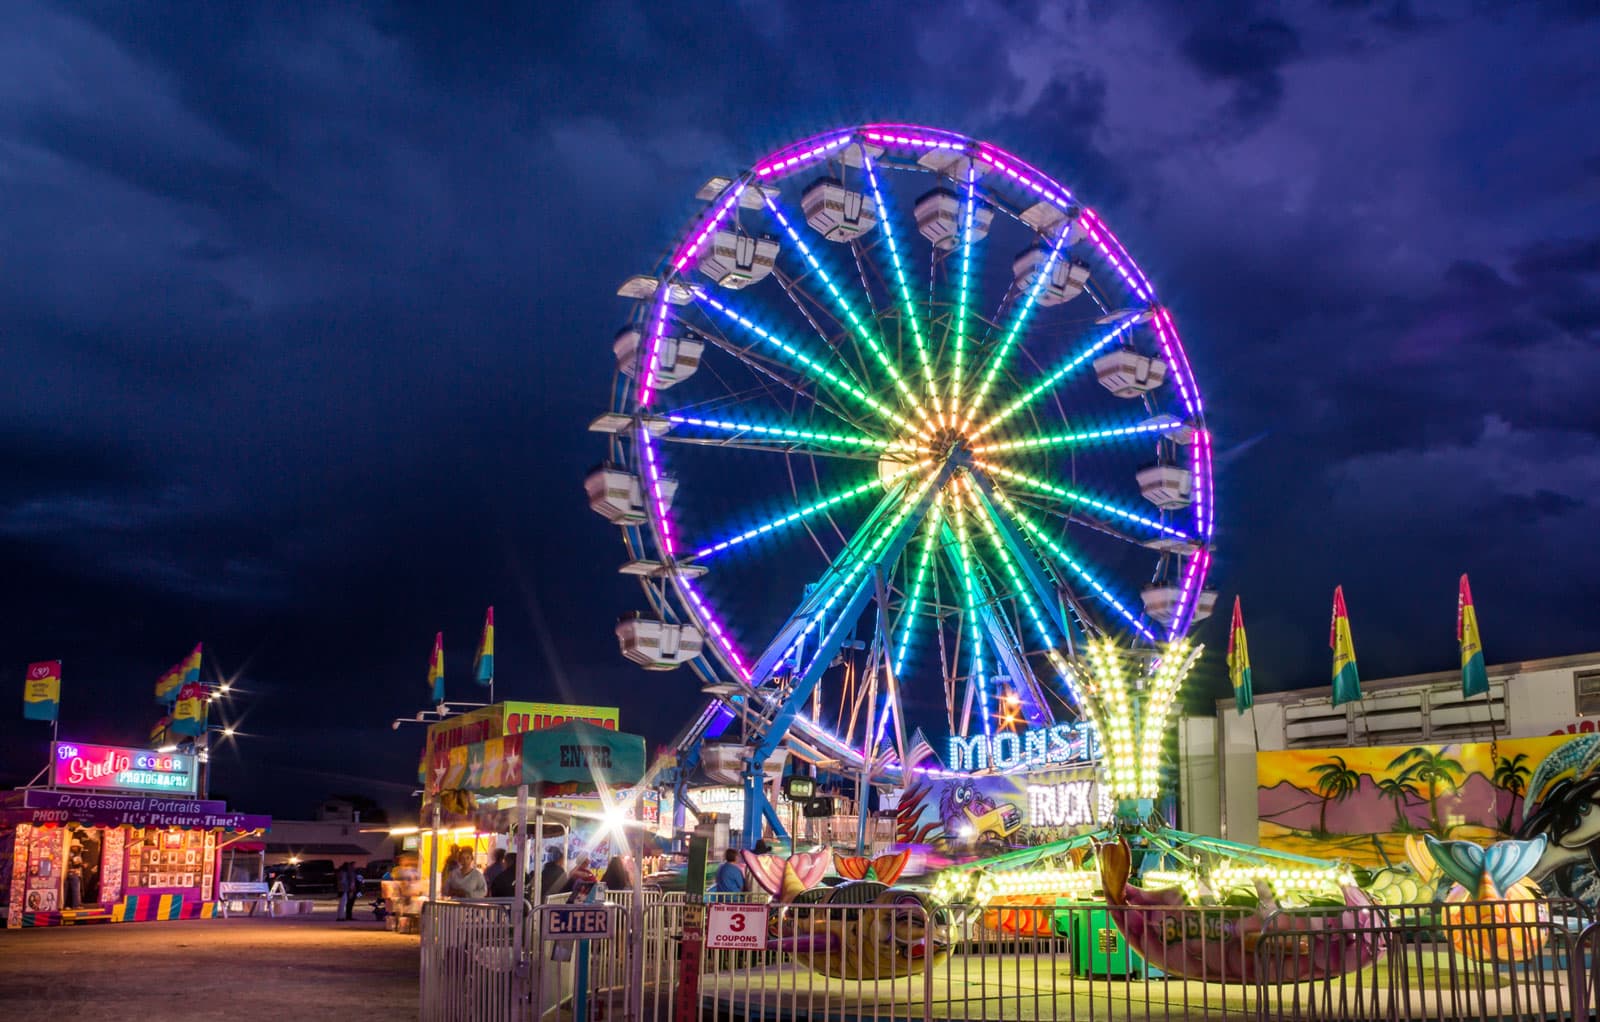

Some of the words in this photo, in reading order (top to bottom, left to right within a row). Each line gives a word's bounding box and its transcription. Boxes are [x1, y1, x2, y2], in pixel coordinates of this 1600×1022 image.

[57, 745, 79, 760] The
[560, 745, 612, 768] ENTER
[68, 751, 130, 784] Studio
[137, 757, 182, 770] COLOR
[119, 771, 189, 787] PHOTOGRAPHY
[57, 795, 145, 811] Professional
[149, 799, 201, 814] Portraits
[1027, 781, 1095, 828] TRUCK
[32, 810, 69, 822] PHOTO
[121, 812, 146, 824] It's
[150, 813, 200, 826] Picture
[204, 815, 239, 827] Time!
[729, 913, 746, 932] 3
[715, 935, 758, 943] COUPONS
